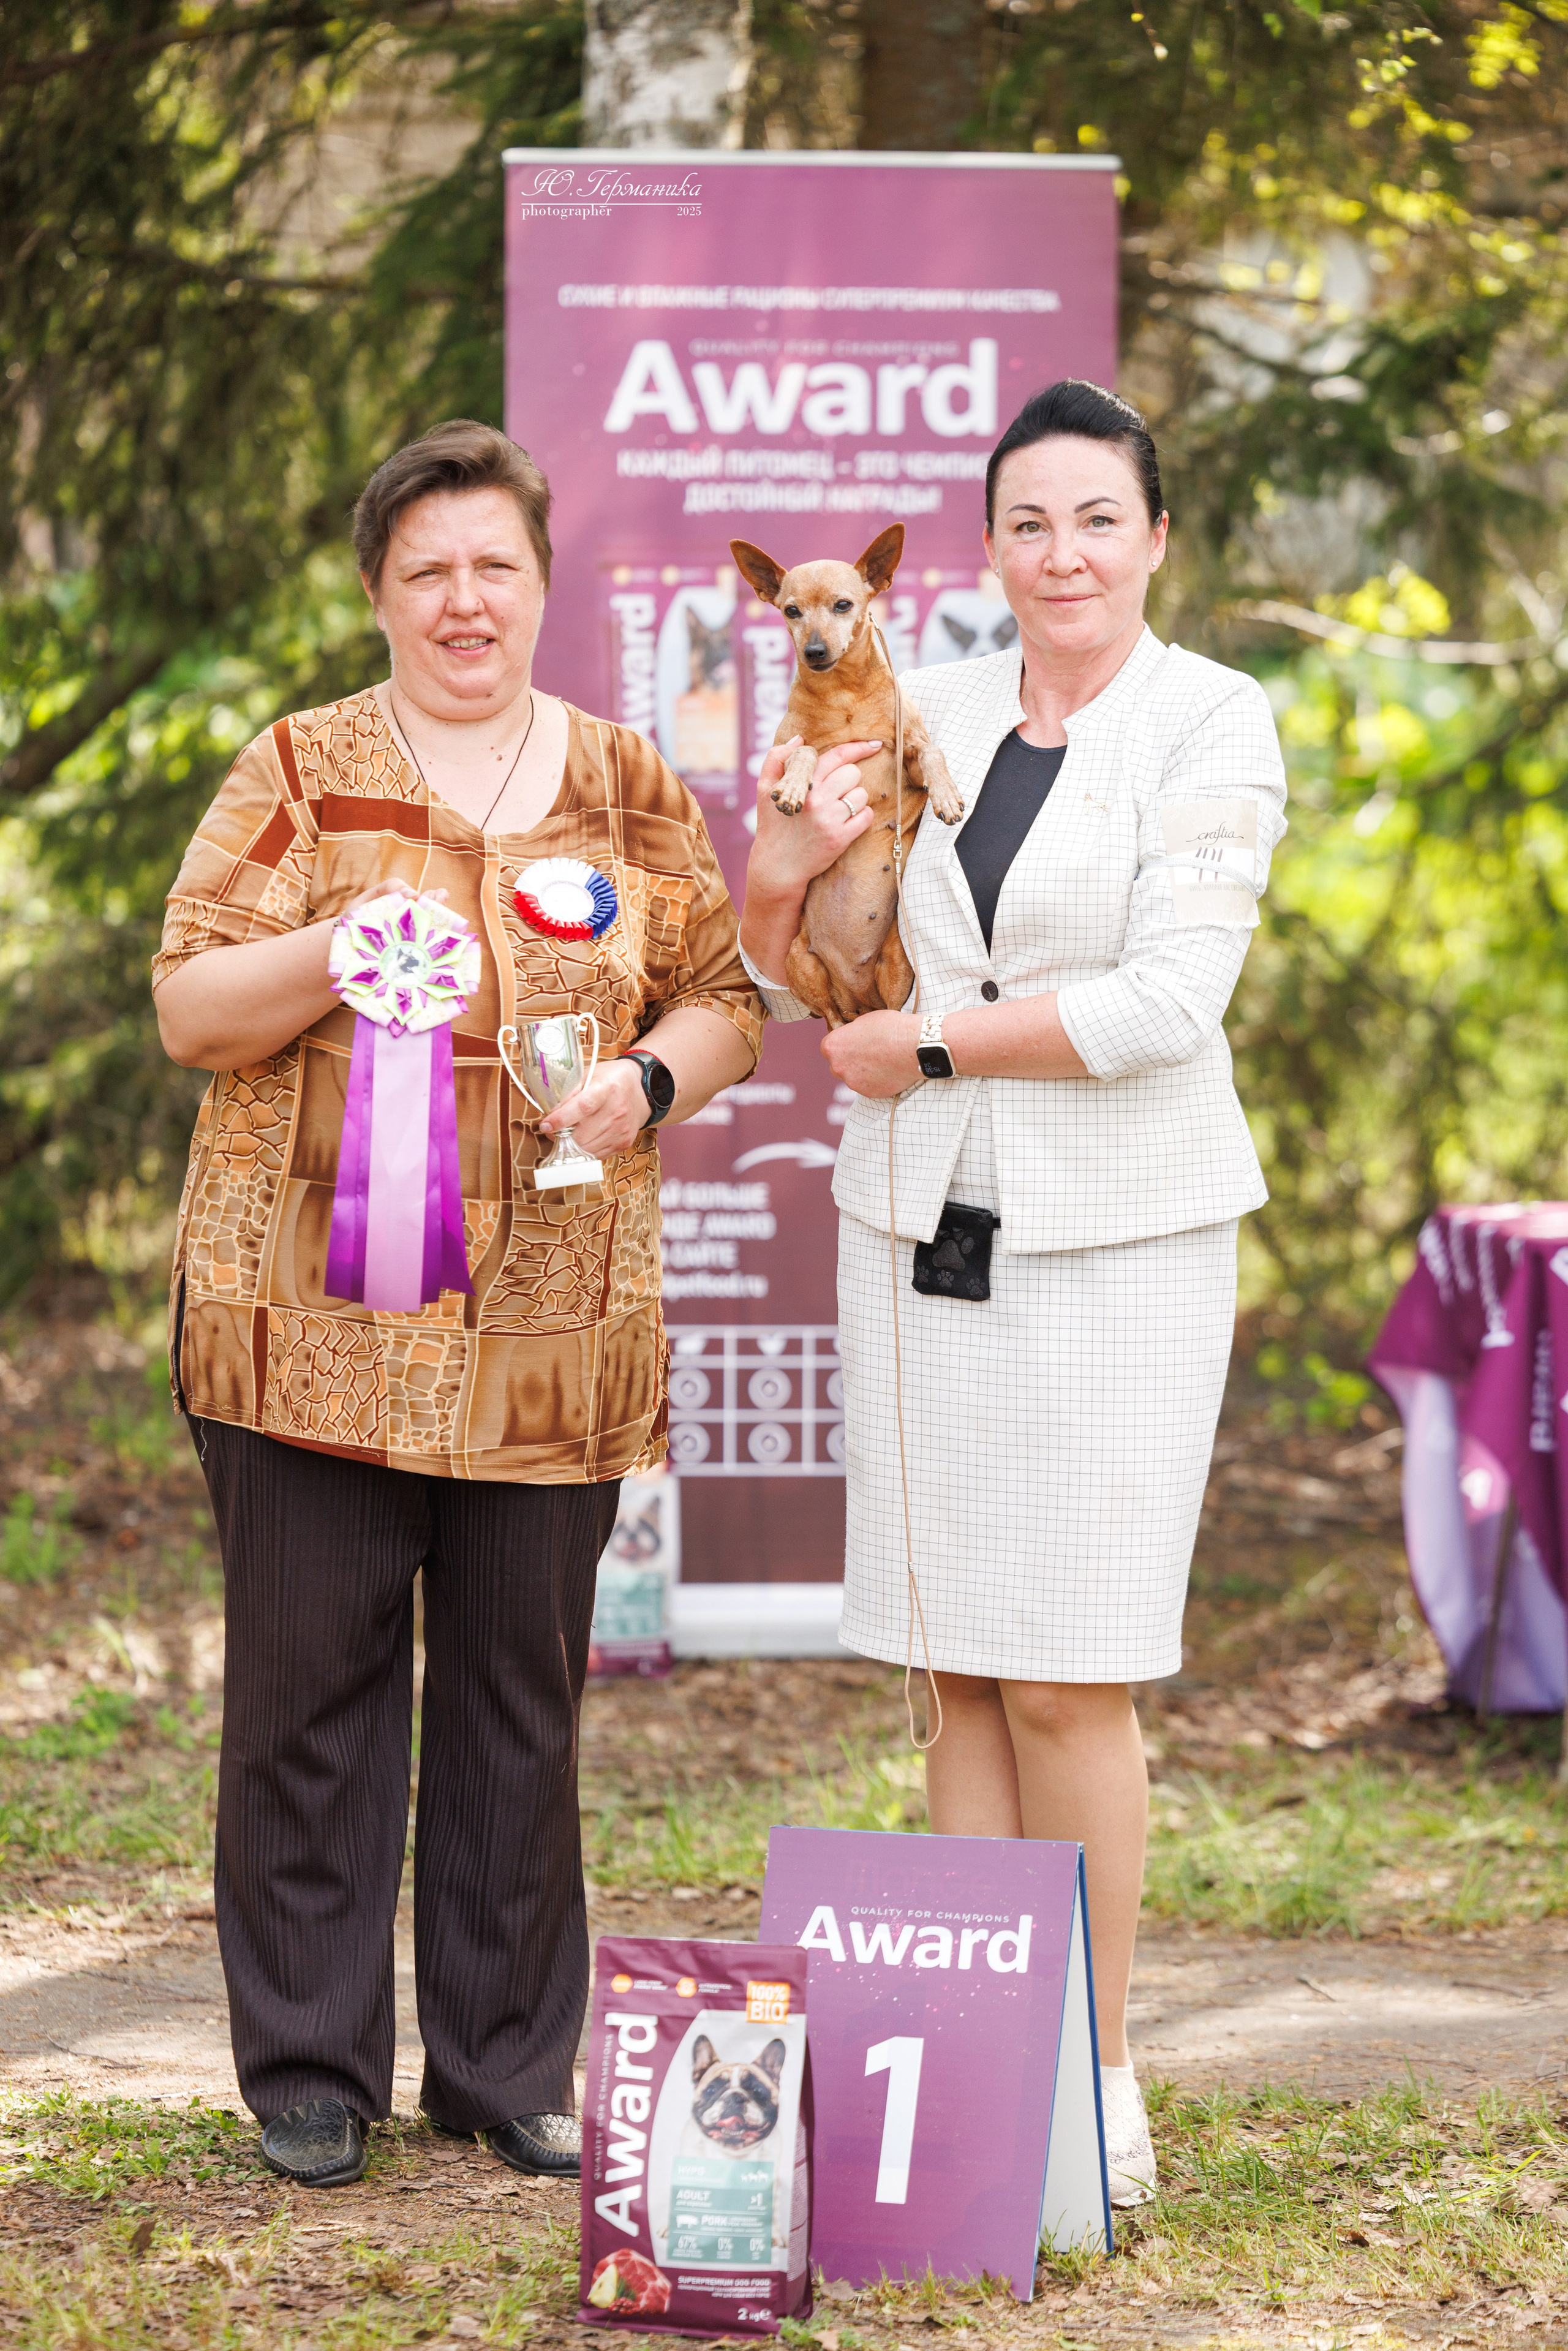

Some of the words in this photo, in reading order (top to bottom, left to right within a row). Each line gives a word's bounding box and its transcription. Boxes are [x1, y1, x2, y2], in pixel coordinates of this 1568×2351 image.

[603, 338, 998, 437] Award
[1185, 821, 1244, 845] craftia
[851, 1906, 902, 1917] QUALITY
[908, 1909, 931, 1919] FOR
[936, 1911, 1010, 1923] CHAMPIONS
[796, 1905, 1033, 1974] Award
[750, 1984, 786, 2001] 100%
[750, 2002, 785, 2021] BIO
[599, 2033, 614, 2100] CHAMPIONS
[595, 2012, 658, 2237] Award
[596, 2105, 606, 2126] FOR
[864, 2036, 924, 2205] 1
[594, 2132, 603, 2180] QUALITY
[676, 2189, 710, 2201] ADULT
[701, 2214, 728, 2227] PORK
[718, 2236, 733, 2251] 0%
[750, 2238, 765, 2251] 0%
[678, 2275, 733, 2285] SUPERPREMIUM
[737, 2308, 748, 2320] 2
